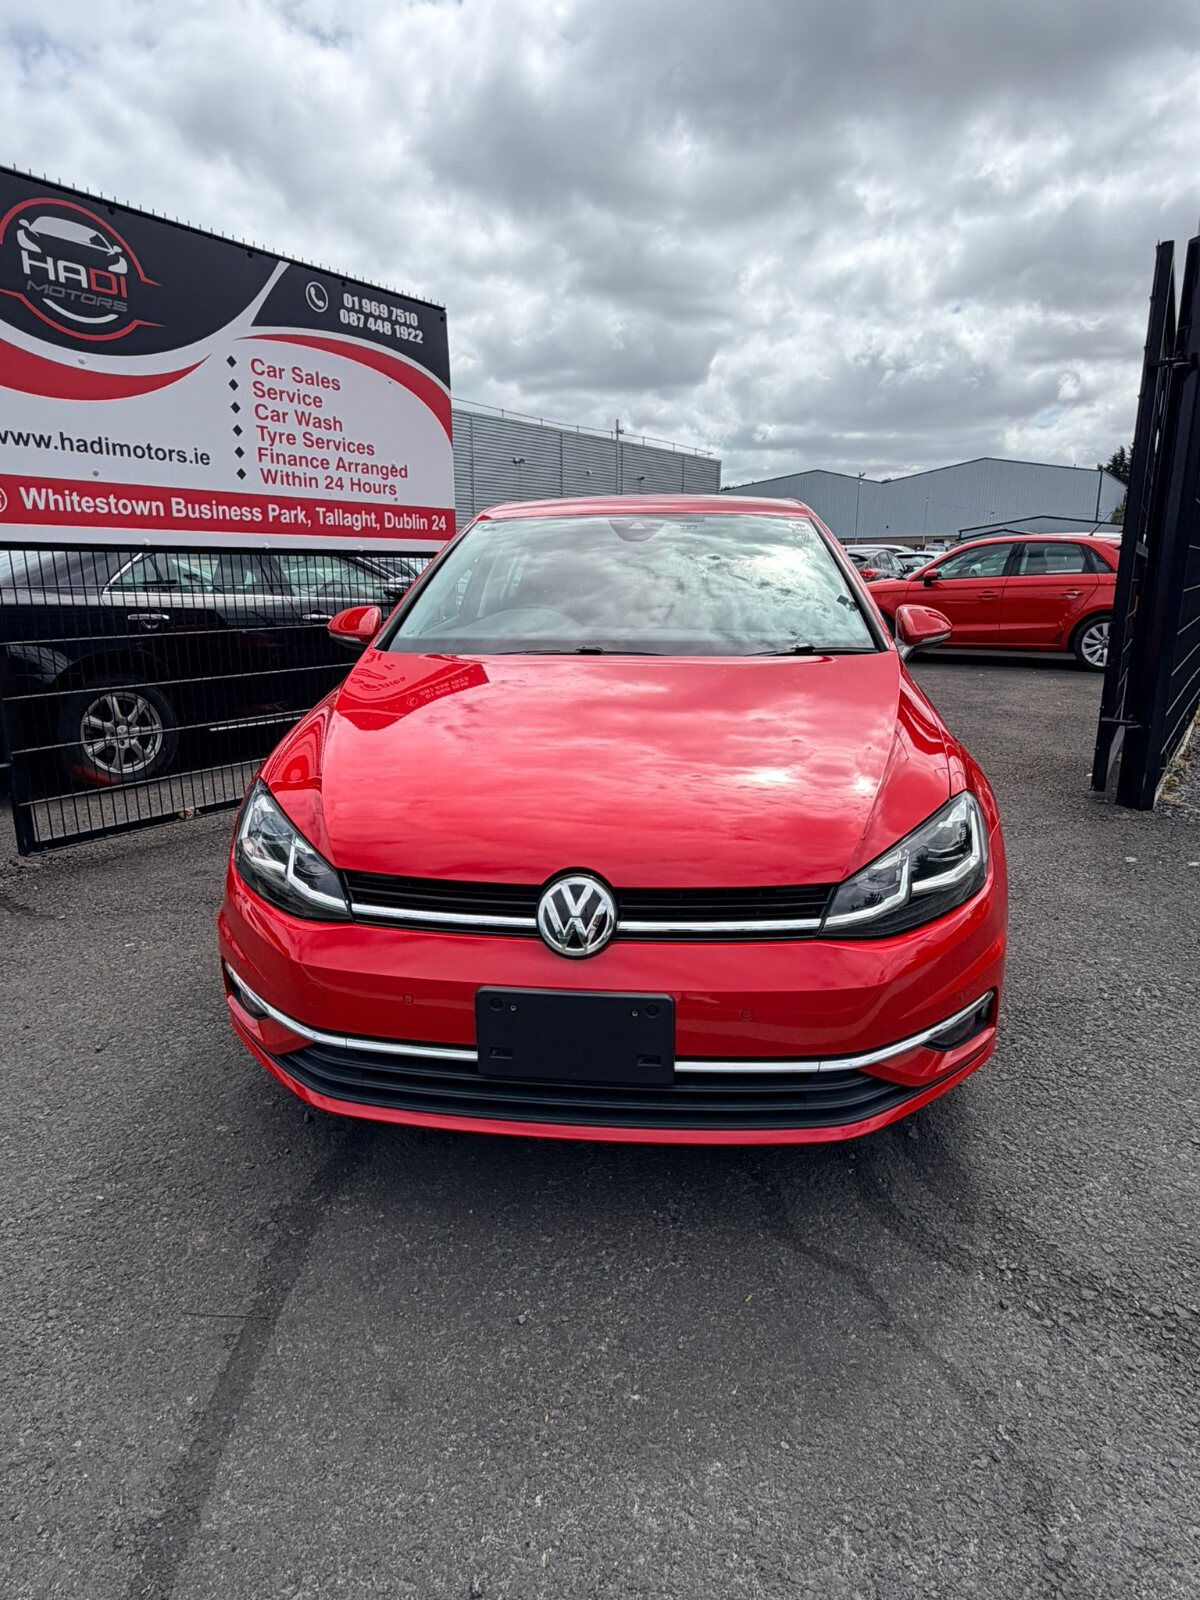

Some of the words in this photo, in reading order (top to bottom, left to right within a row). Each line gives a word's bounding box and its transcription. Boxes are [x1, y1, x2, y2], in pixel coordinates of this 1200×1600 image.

[20, 249, 128, 299] HADI
[26, 280, 128, 312] MOTORS
[342, 293, 359, 309] 01
[361, 298, 389, 318] 969
[391, 306, 419, 327] 7510
[339, 309, 364, 329] 087
[366, 316, 392, 336] 448
[394, 324, 424, 344] 1922
[250, 358, 285, 381] Car
[291, 366, 341, 391] Sales
[252, 380, 323, 408] Service
[254, 403, 288, 424] Car
[294, 409, 343, 432] Wash
[255, 424, 297, 447] Tyre
[303, 431, 375, 456] Services
[257, 447, 330, 470] Finance
[335, 457, 408, 480] Arranged
[260, 467, 319, 489] Within
[324, 476, 344, 491] 24
[350, 477, 397, 496] Hours
[19, 486, 165, 517] Whitestown
[170, 497, 262, 523] Business
[267, 503, 312, 527] Park,
[316, 507, 380, 531] Tallaght,
[384, 512, 428, 530] Dublin
[431, 515, 446, 531] 24
